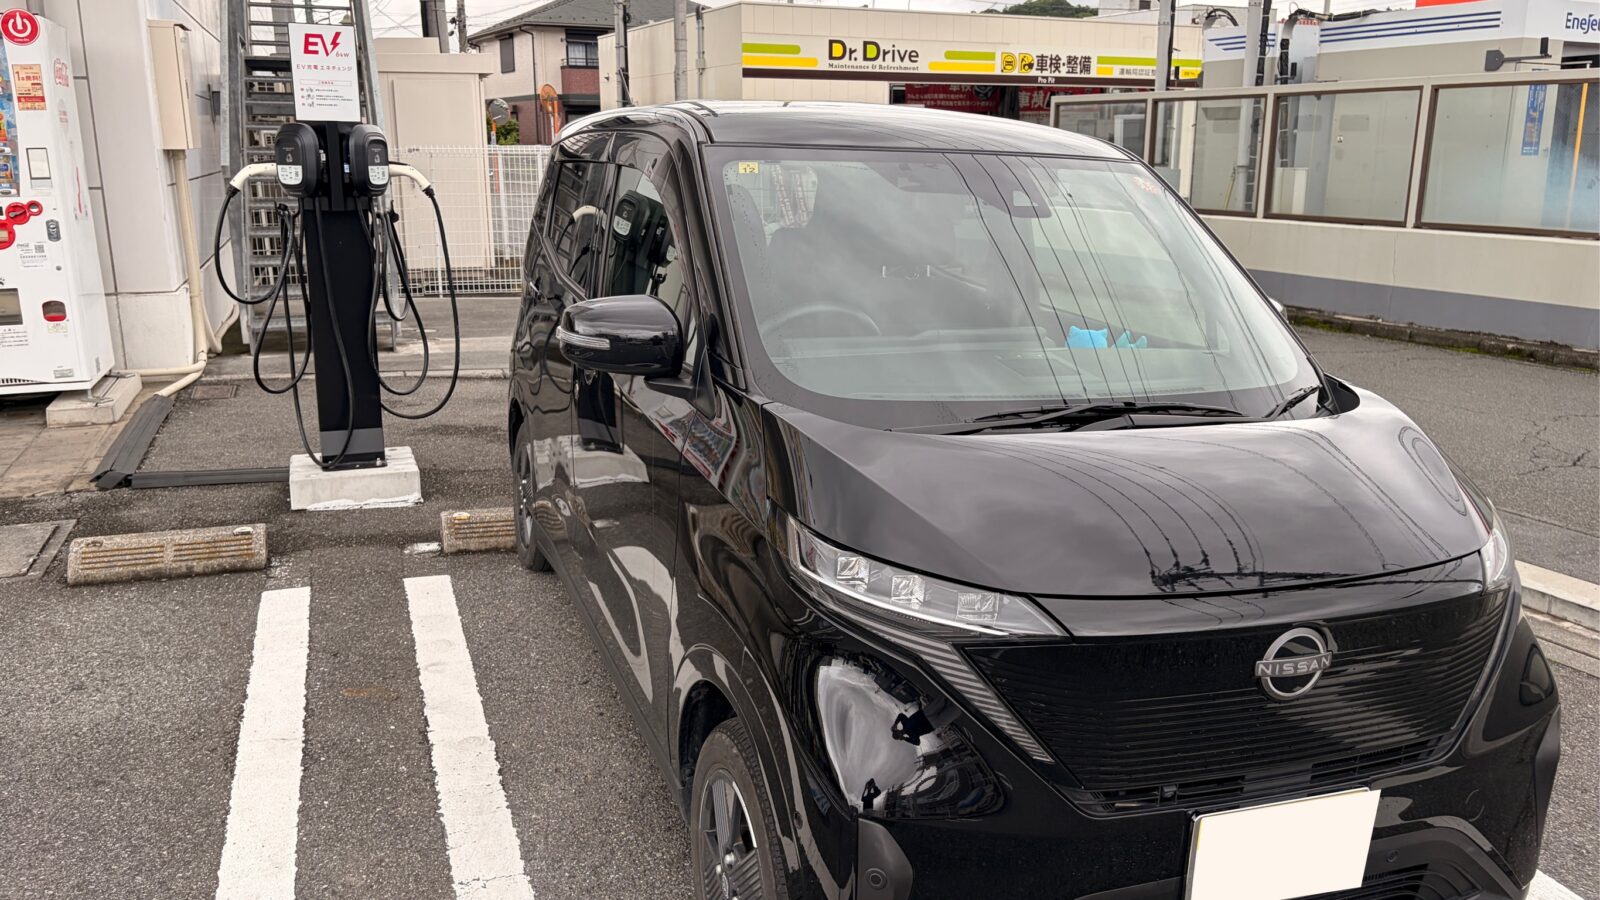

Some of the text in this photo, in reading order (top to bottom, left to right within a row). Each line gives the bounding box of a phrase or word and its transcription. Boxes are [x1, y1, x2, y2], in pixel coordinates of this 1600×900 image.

[303, 31, 342, 57] EV
[828, 39, 920, 63] Dr. Drive
[828, 62, 870, 70] Maintenance
[1035, 53, 1092, 75] 車検・整備
[1257, 656, 1331, 676] NISSAN
